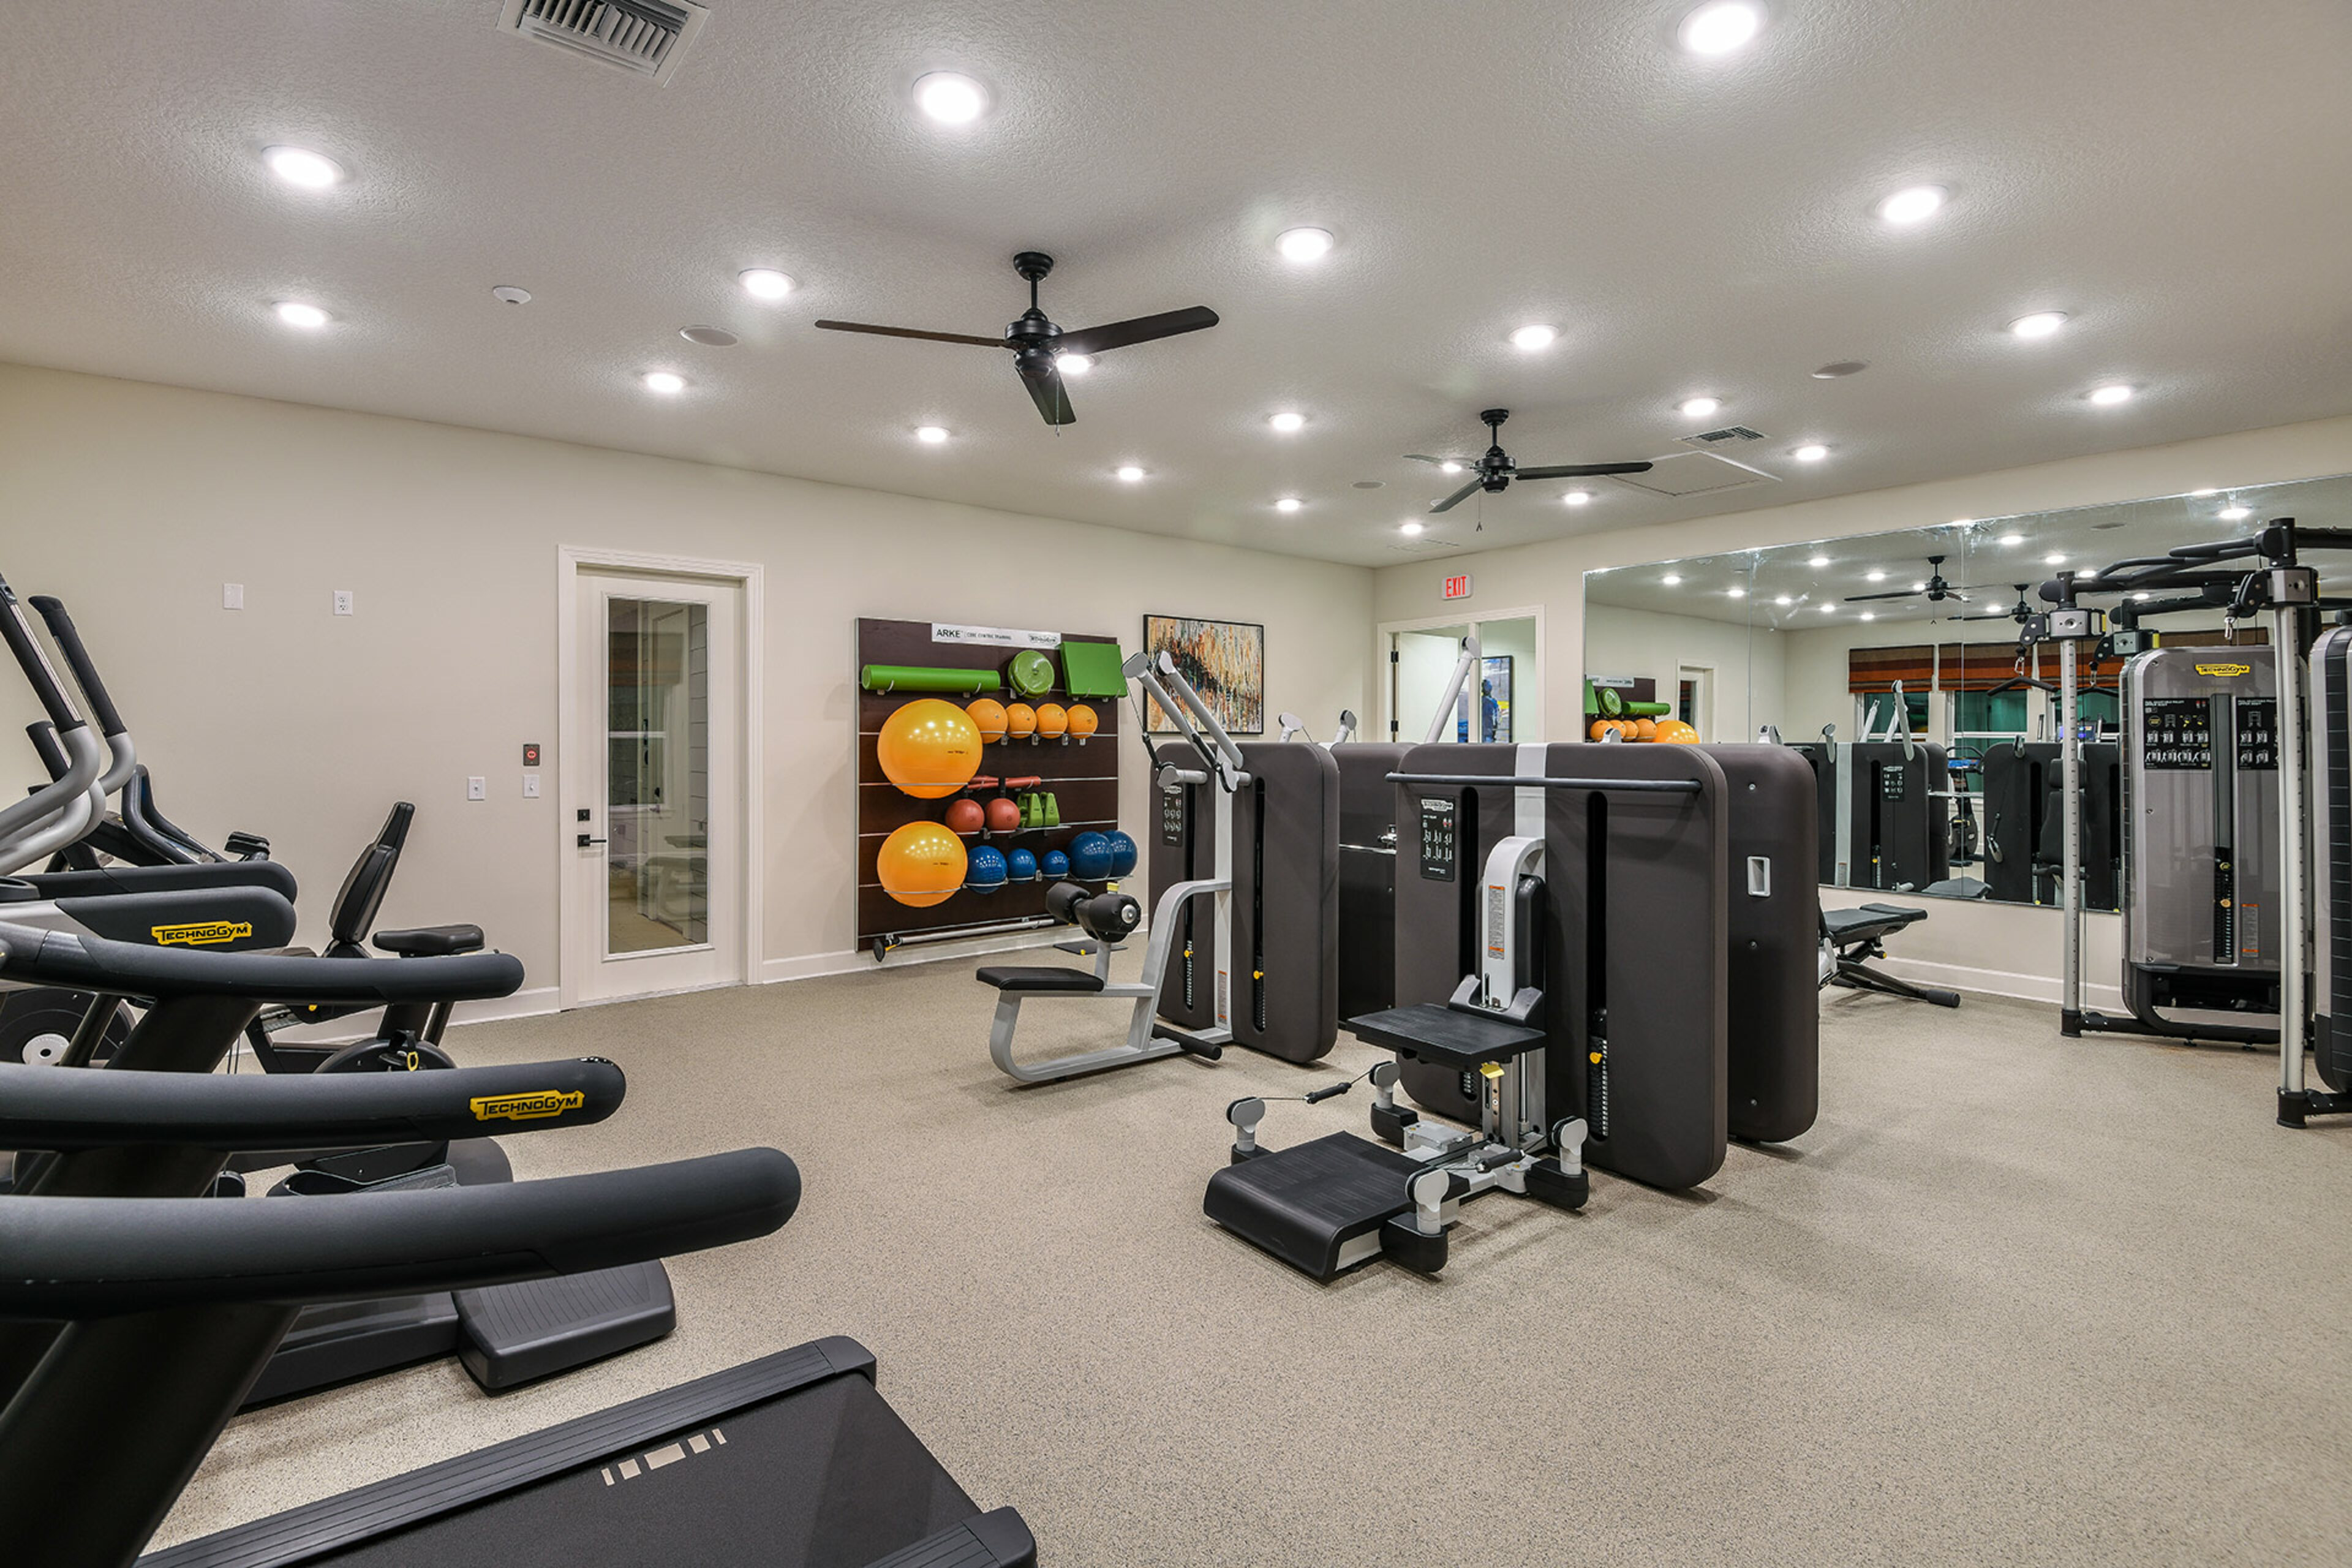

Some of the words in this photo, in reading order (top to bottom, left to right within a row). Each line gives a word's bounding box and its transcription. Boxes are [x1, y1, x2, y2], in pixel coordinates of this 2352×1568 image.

[1446, 576, 1466, 597] EXIT
[937, 629, 961, 638] ARKE
[155, 925, 248, 942] TECHNOGYM
[477, 1095, 578, 1116] TECHNOGYM
